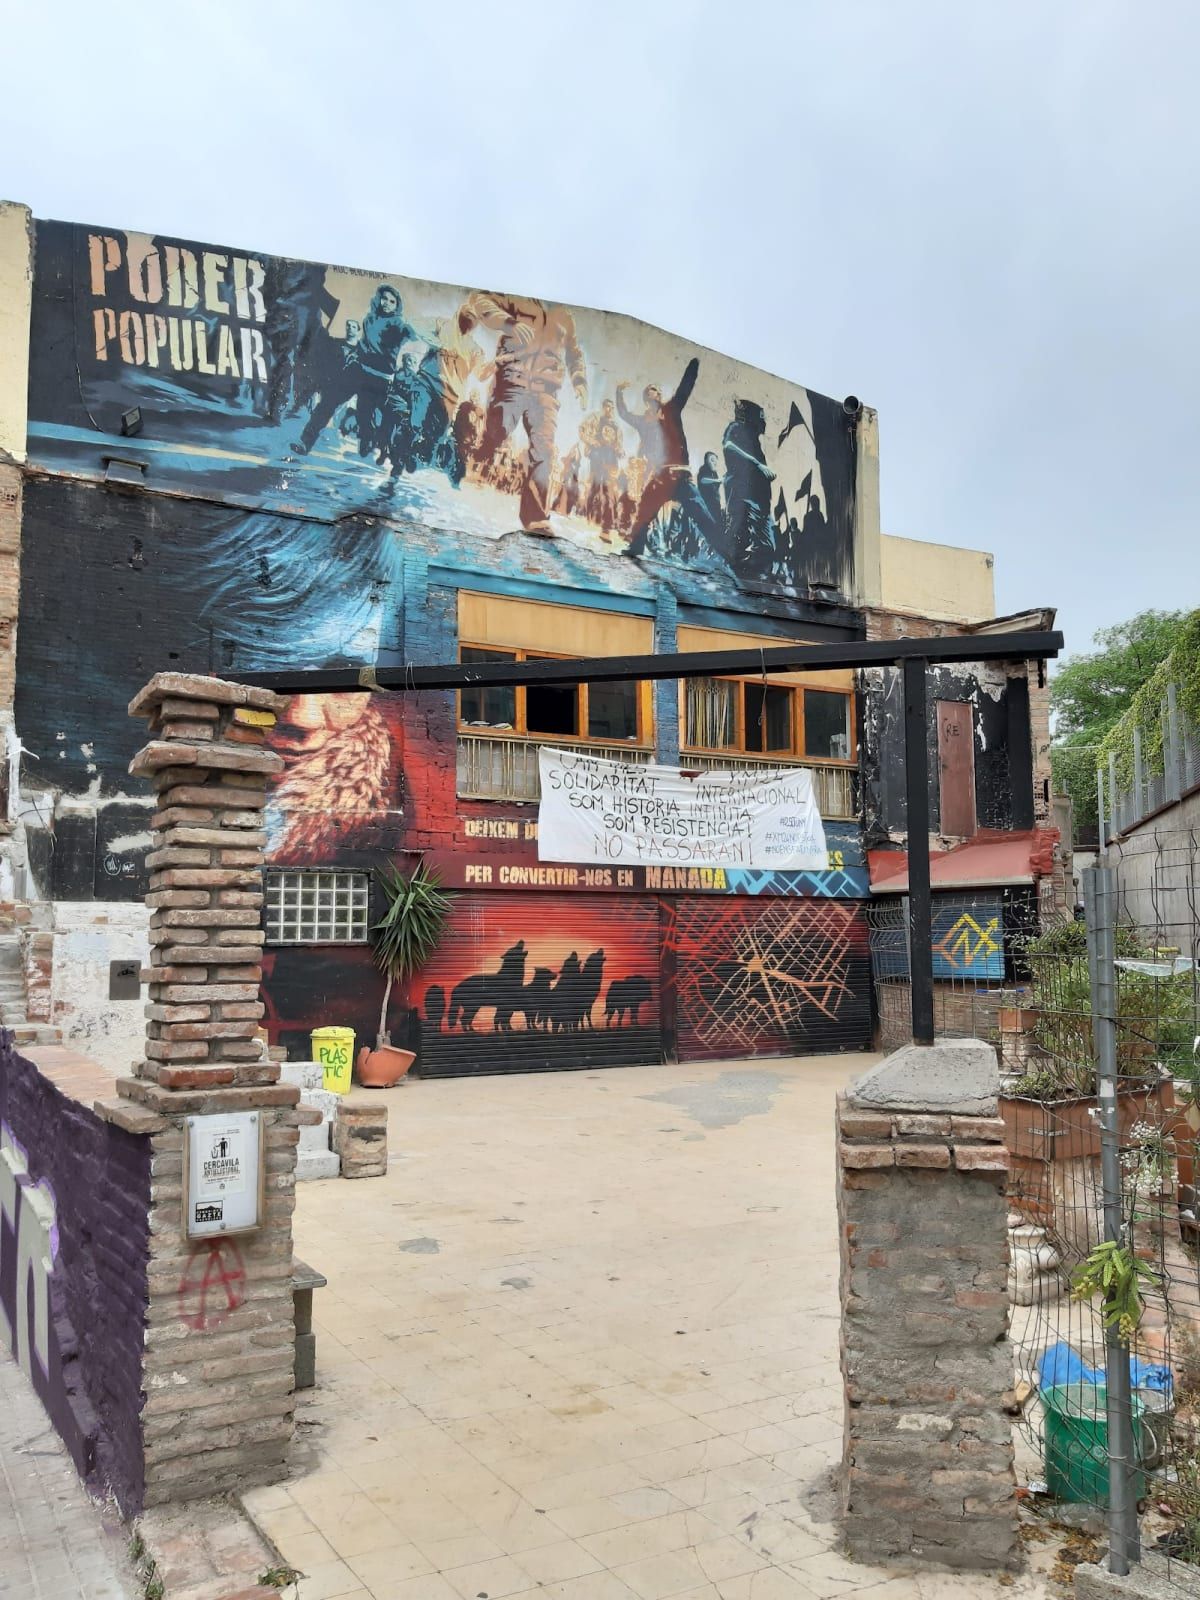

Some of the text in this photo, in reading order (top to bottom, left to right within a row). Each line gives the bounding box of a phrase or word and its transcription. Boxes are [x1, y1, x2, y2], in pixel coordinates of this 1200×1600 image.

[88, 234, 266, 323] PODER
[93, 307, 268, 384] POPULAR
[549, 769, 806, 806] SOLIDARITAT INTERNACIONAL
[568, 792, 604, 811] SOM
[613, 795, 681, 817] HISTORIA
[465, 819, 518, 839] DEIXEM
[603, 813, 754, 839] SOM RESISTENCIA!
[634, 835, 753, 865] PASSARAN!
[465, 865, 727, 889] PER CONVERTIR-NOS EN MANADA
[203, 1158, 240, 1170] CERCAVILA
